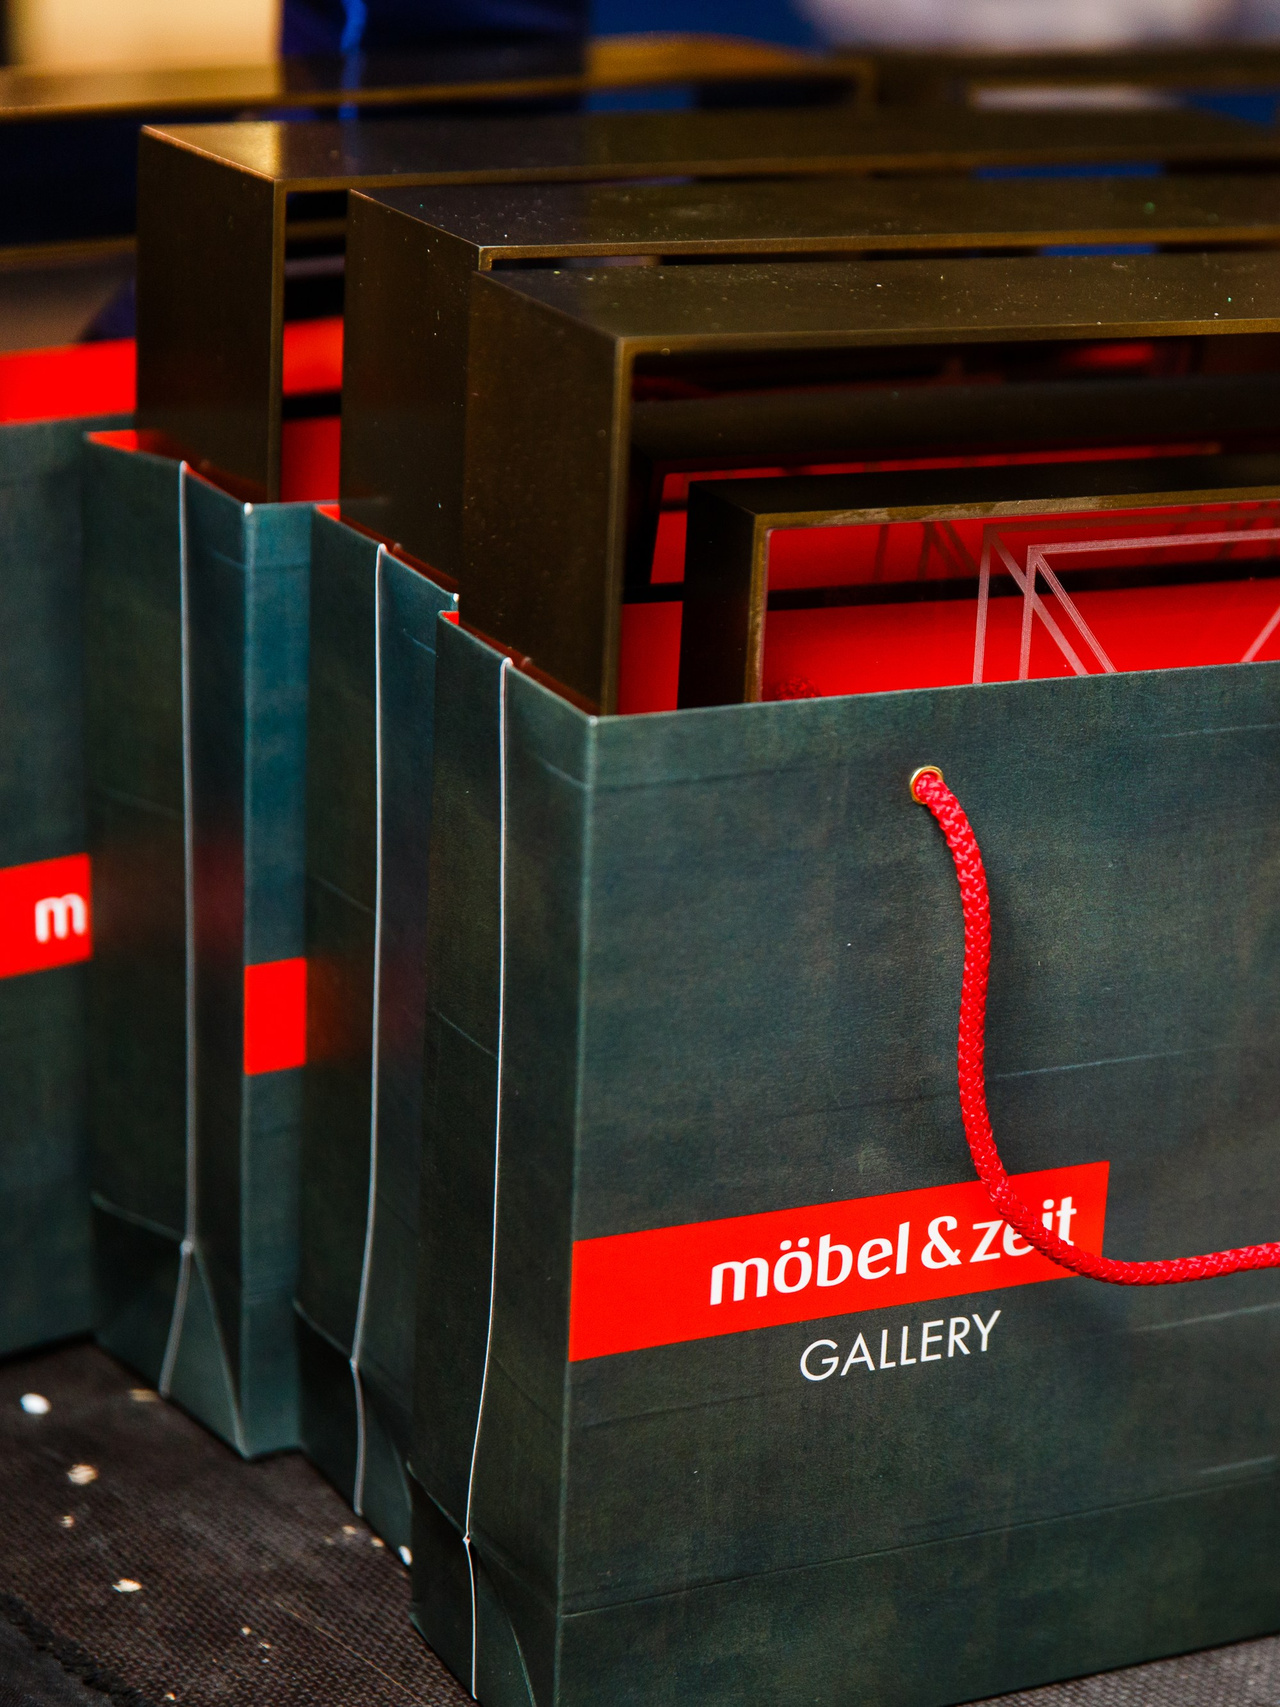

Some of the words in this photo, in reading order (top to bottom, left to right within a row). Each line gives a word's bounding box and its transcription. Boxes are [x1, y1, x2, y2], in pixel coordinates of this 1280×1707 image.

[710, 1222, 910, 1305] möbel
[921, 1216, 962, 1269] &
[799, 1310, 1002, 1381] GALLERY
